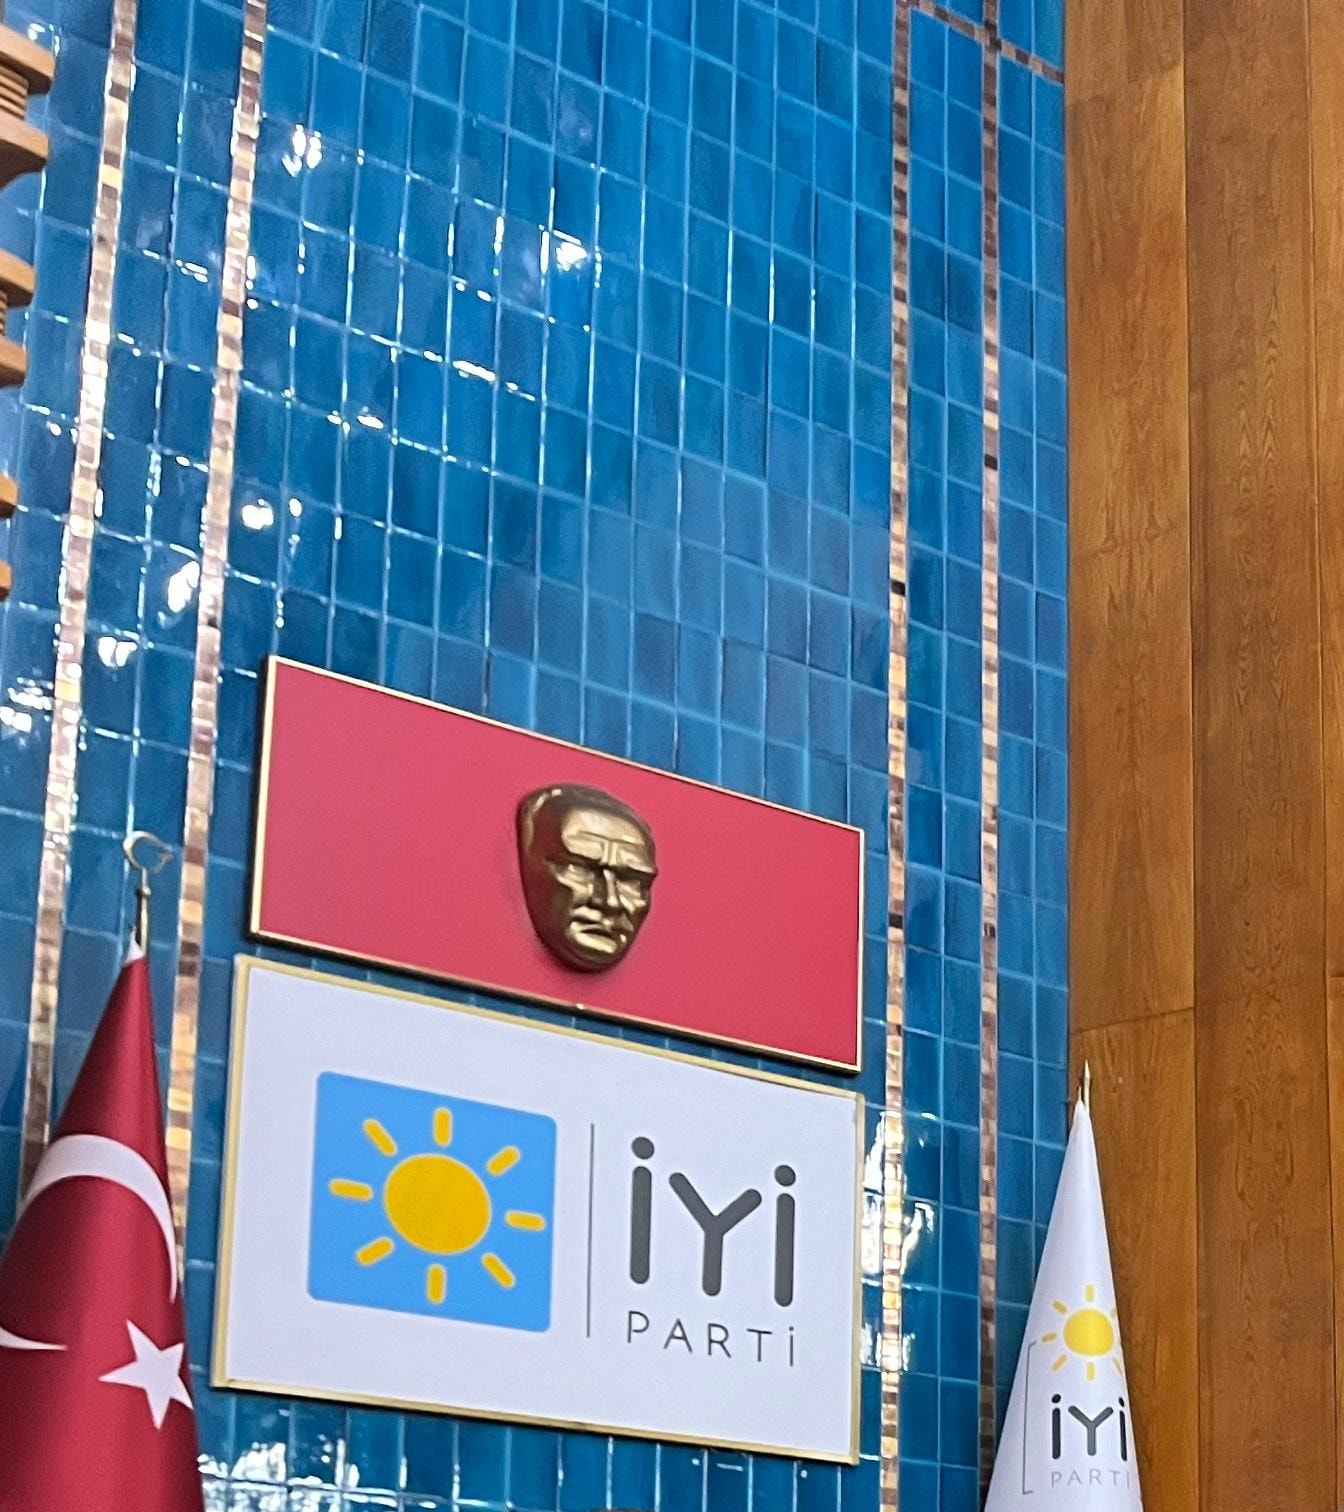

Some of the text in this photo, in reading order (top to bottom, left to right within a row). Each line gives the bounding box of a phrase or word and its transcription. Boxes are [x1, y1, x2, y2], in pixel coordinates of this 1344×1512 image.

[630, 1136, 797, 1307] İYİ
[626, 1310, 795, 1367] PARTİ
[1051, 1393, 1128, 1462] İYİ
